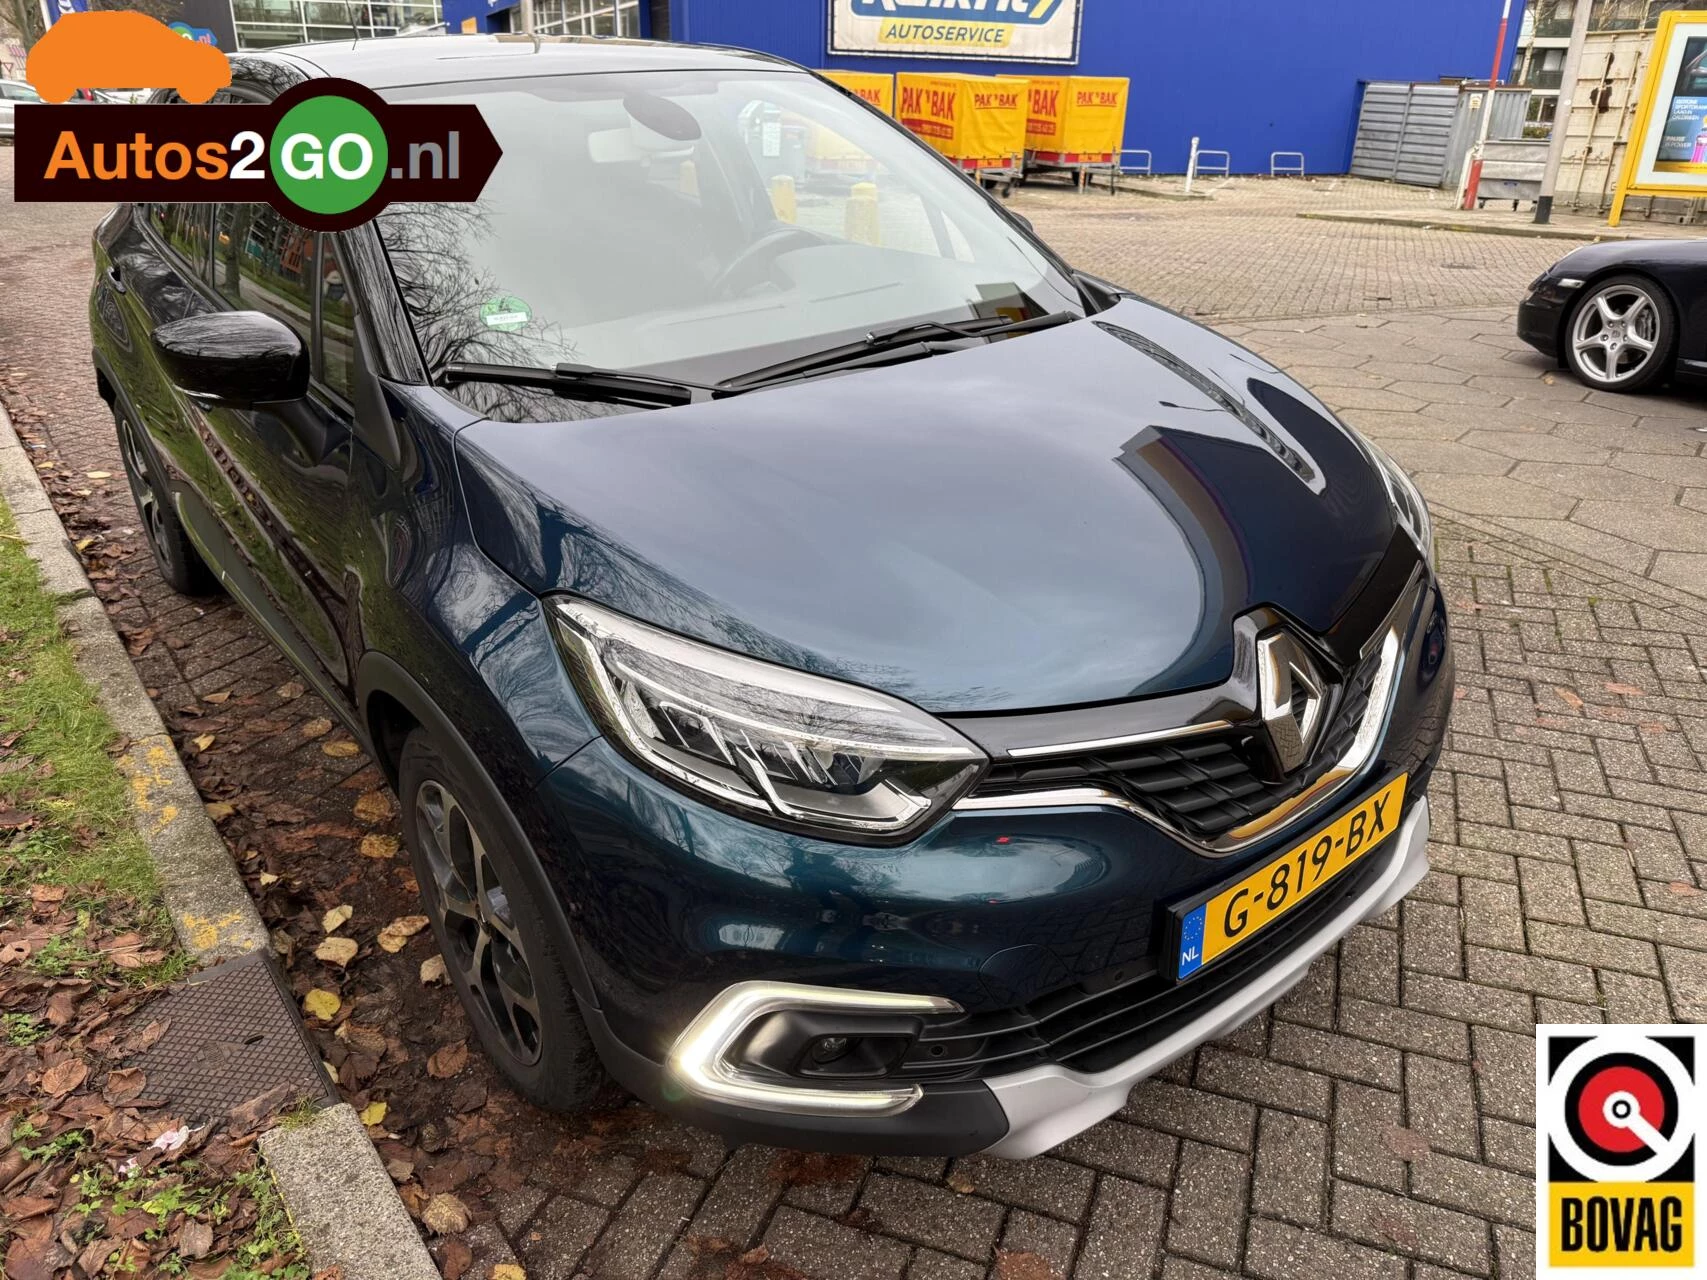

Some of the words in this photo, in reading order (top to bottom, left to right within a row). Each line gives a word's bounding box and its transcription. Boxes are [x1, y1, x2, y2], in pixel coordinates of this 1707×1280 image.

[885, 23, 1005, 43] AUTOSERVICE
[901, 86, 923, 114] PAK
[931, 90, 956, 121] BAK
[974, 93, 992, 106] PAK
[998, 93, 1018, 107] BAK
[1032, 89, 1059, 117] BAK
[1077, 91, 1094, 105] PAK
[1100, 91, 1119, 105] BAK
[1223, 790, 1391, 938] G-819-BX
[1181, 946, 1199, 966] NL
